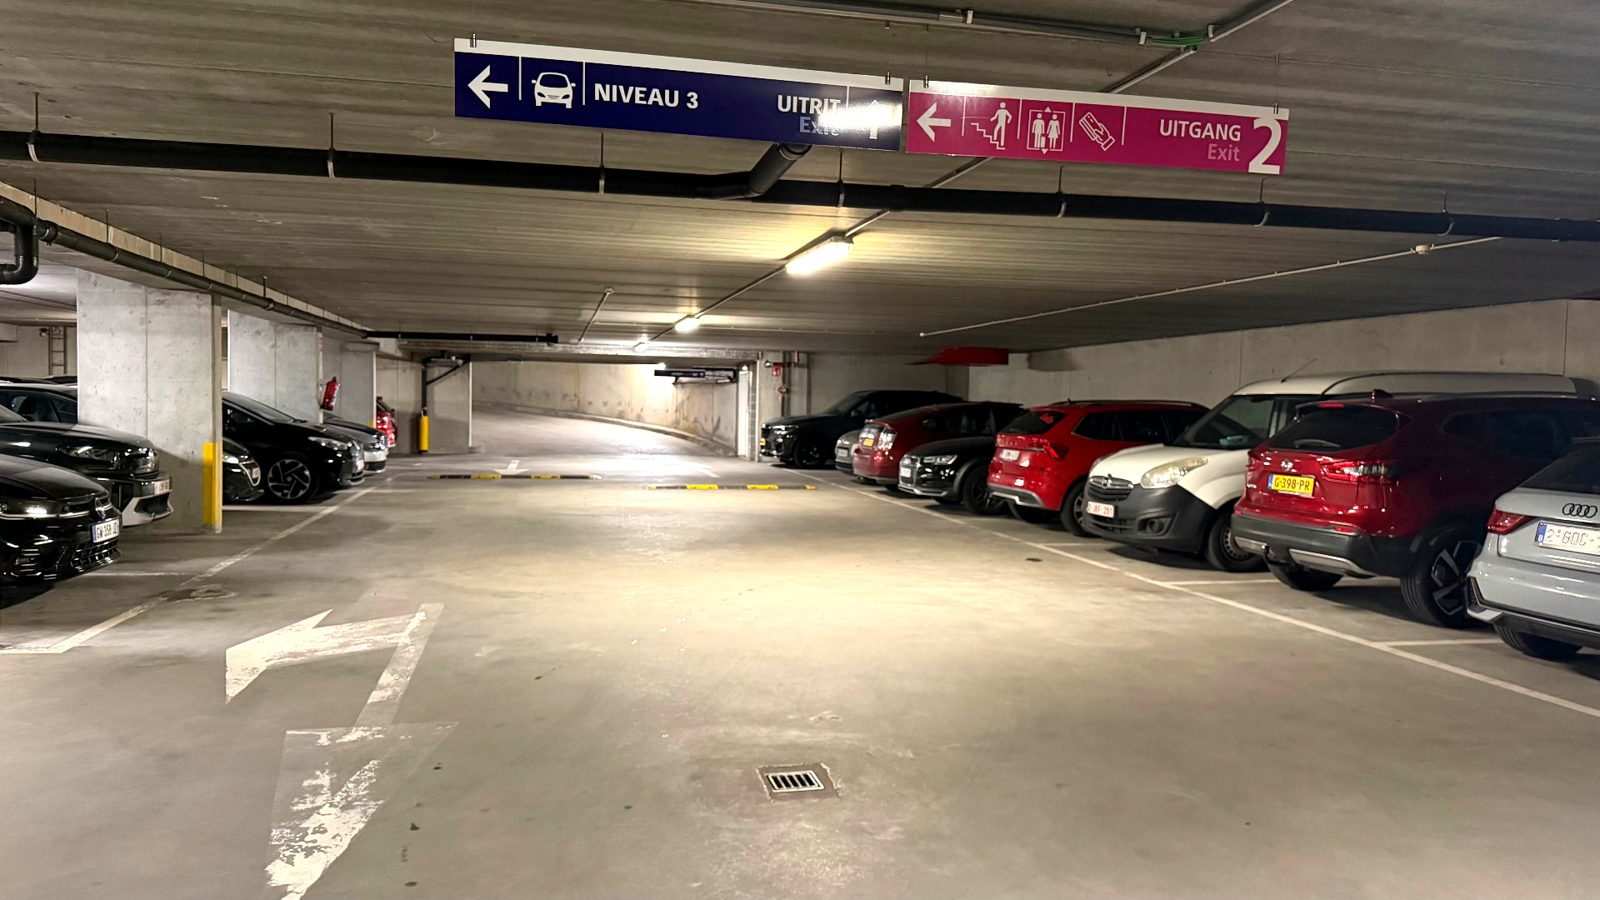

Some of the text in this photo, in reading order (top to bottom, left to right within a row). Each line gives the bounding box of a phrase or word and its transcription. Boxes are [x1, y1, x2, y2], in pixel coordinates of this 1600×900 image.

[594, 83, 699, 109] NIVEAU 3
[777, 94, 841, 115] UITRIT
[1160, 118, 1241, 142] UITGANG
[1207, 143, 1240, 161] Exit
[1248, 117, 1282, 175] 2
